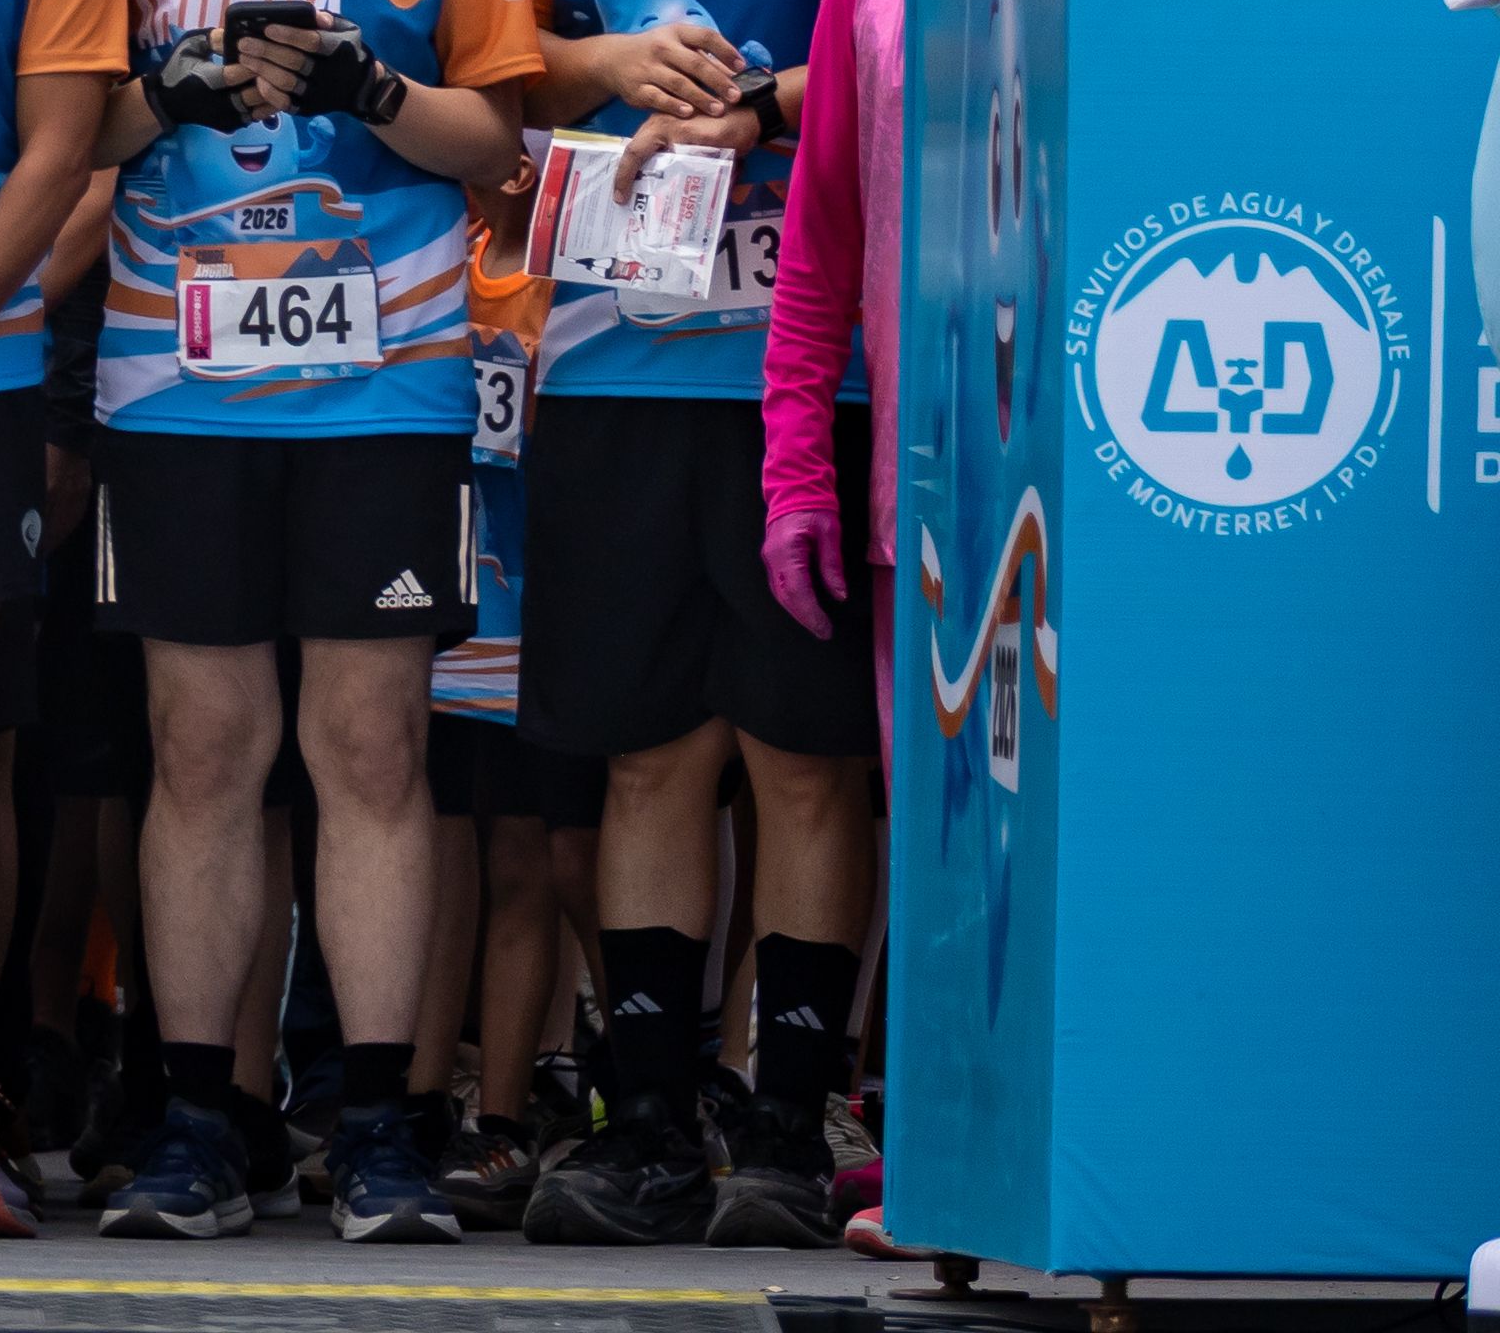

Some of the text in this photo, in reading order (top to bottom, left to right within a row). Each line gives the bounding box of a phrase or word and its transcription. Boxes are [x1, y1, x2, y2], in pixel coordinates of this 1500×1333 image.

[239, 207, 288, 231] 2026
[1066, 192, 1411, 360] SERVICIOS DE AGUA Y DRENAJE
[238, 283, 353, 347] 464
[1093, 440, 1129, 483] DE
[1126, 481, 1323, 536] MONTERREY,
[375, 591, 433, 609] adidas
